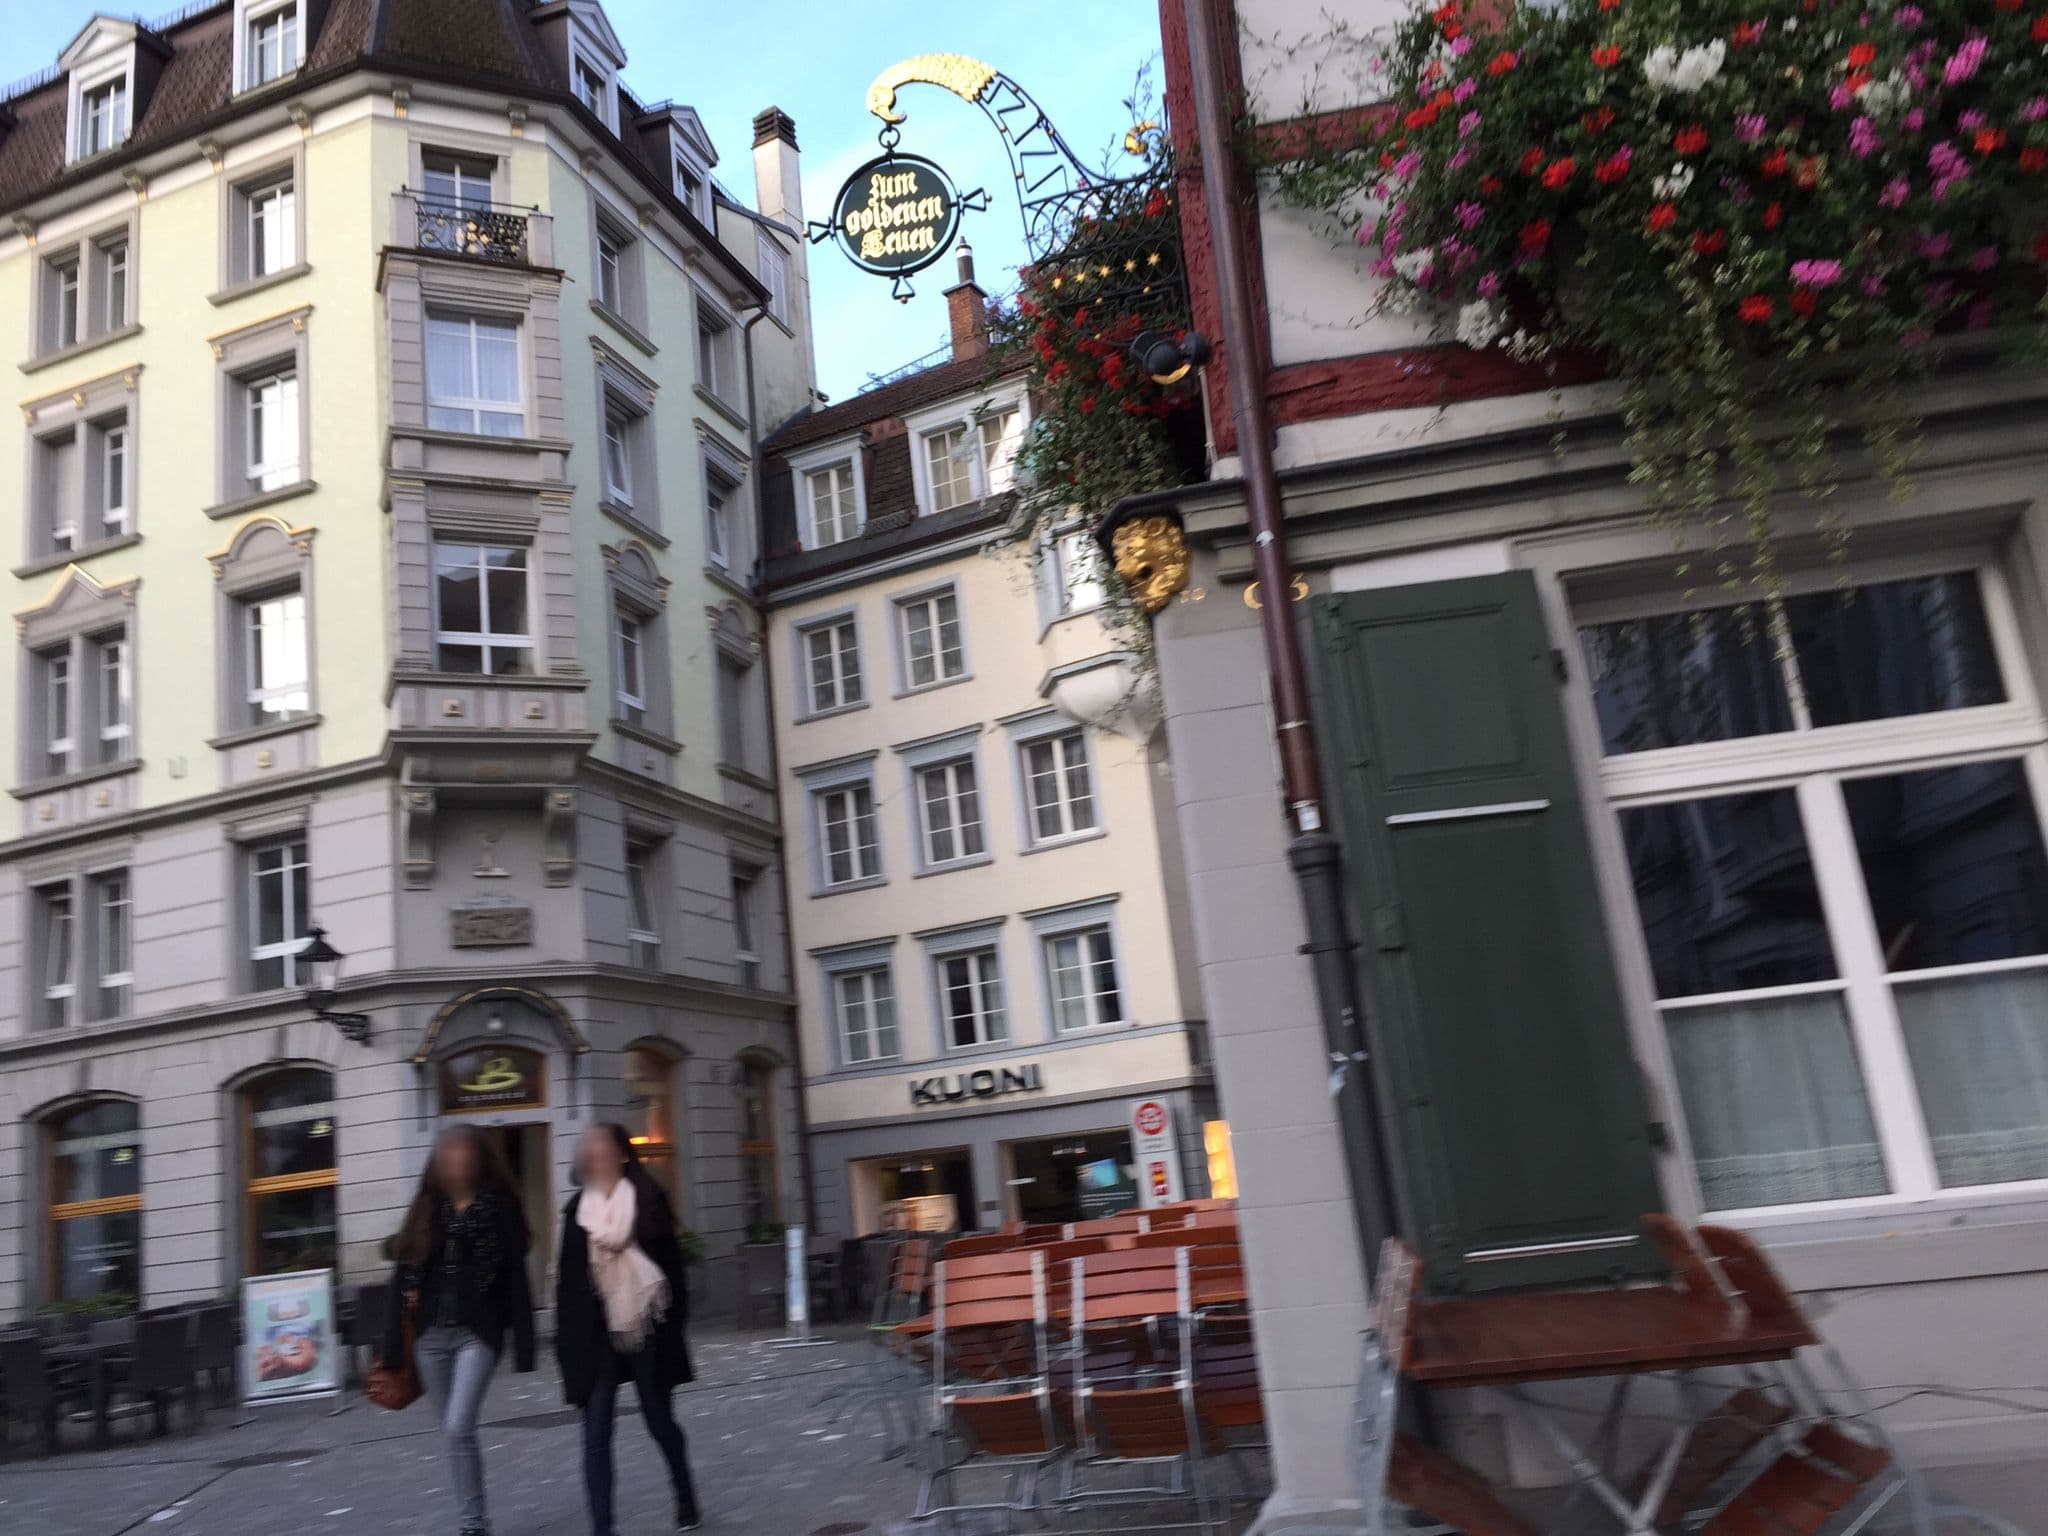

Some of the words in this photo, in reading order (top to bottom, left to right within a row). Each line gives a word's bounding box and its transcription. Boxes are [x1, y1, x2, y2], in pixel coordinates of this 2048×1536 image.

[869, 171, 917, 205] Zum
[846, 196, 944, 236] goldenen
[909, 1063, 1043, 1106] KUONI
